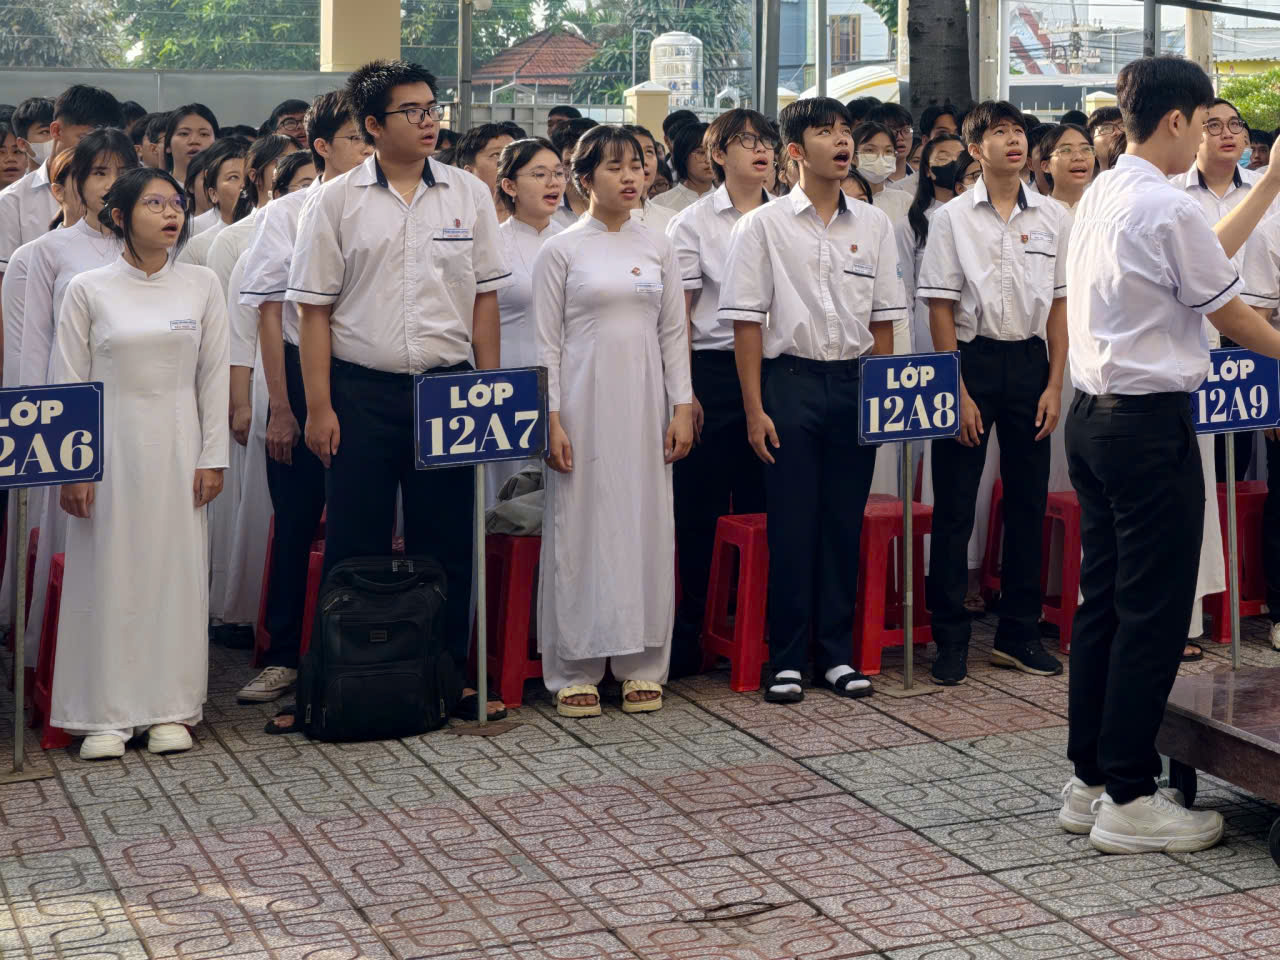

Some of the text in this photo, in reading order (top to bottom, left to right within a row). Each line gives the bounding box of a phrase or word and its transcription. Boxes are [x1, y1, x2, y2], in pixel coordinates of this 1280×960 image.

[886, 361, 936, 390] LỚP
[1207, 355, 1255, 383] LỚP
[450, 378, 514, 409] LỚP
[1195, 384, 1269, 425] 12A9
[865, 392, 956, 434] 12A8
[425, 409, 539, 457] 12A7
